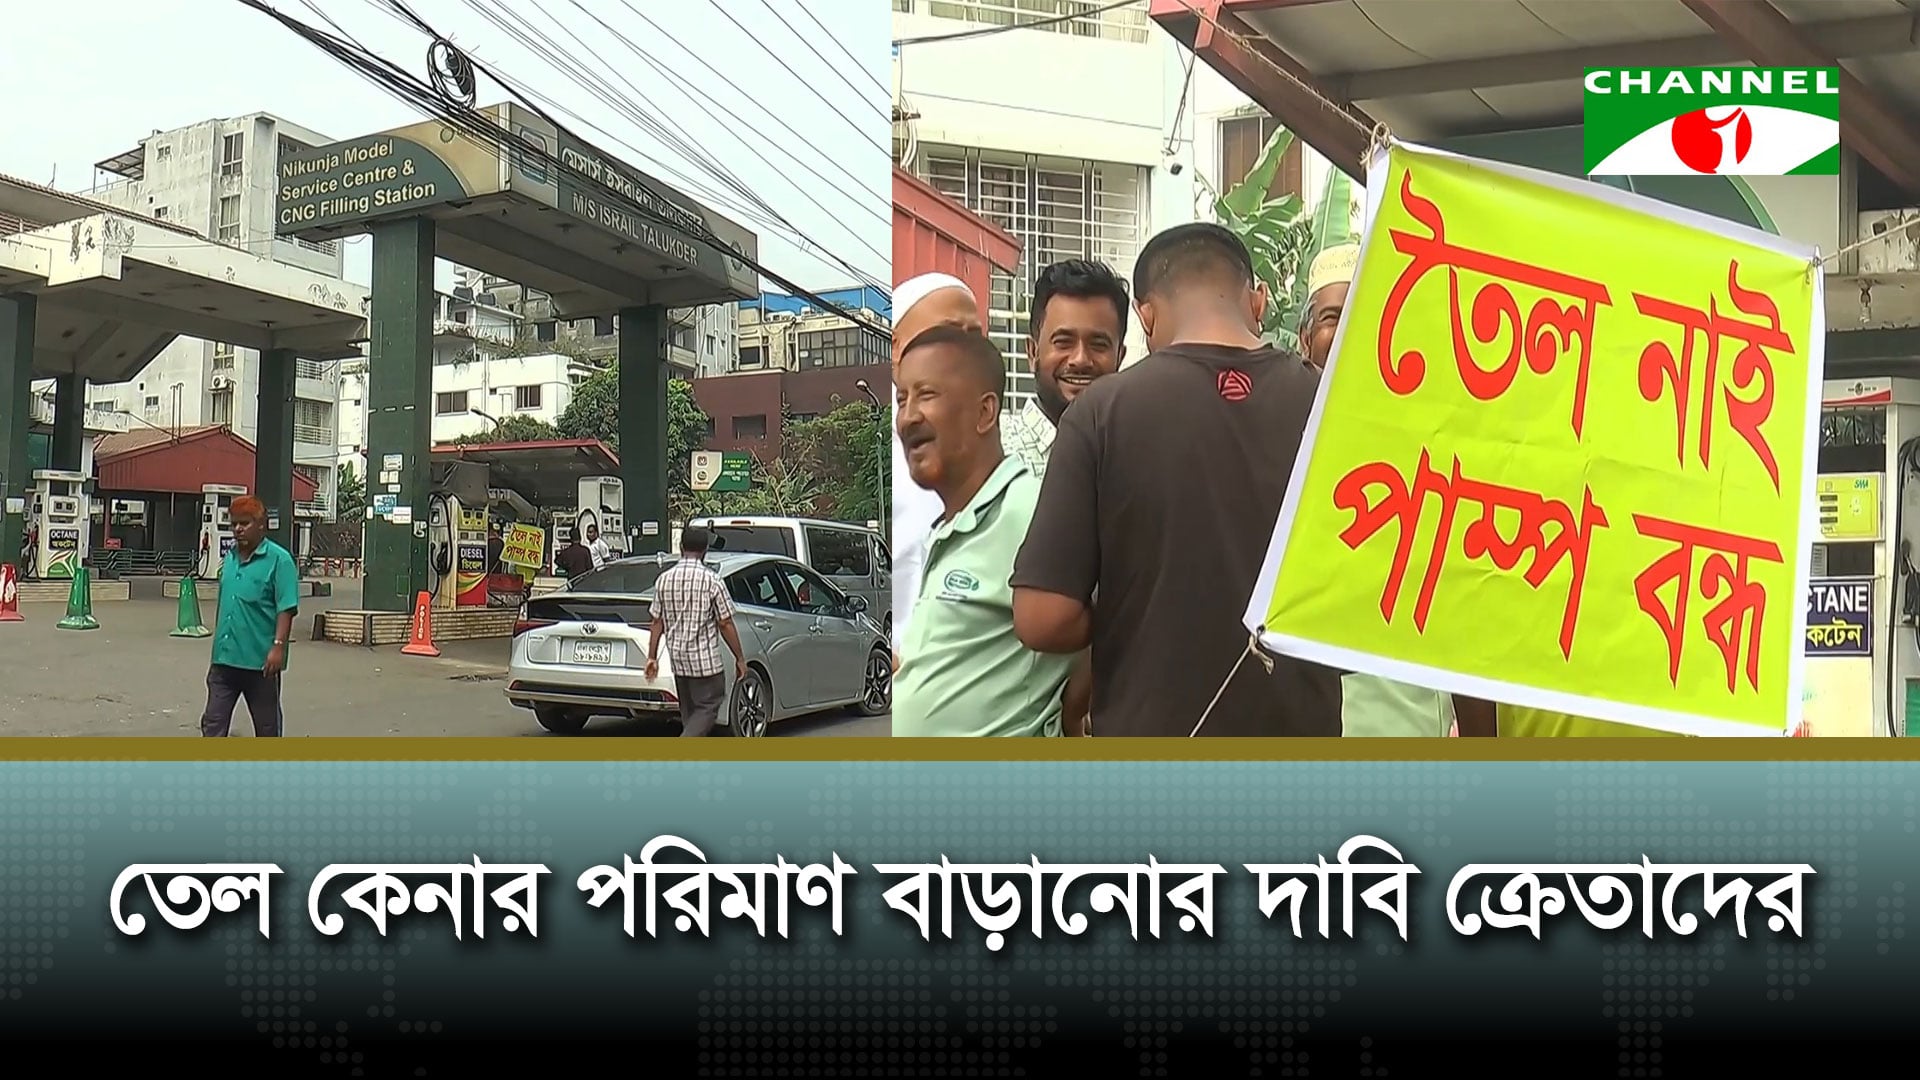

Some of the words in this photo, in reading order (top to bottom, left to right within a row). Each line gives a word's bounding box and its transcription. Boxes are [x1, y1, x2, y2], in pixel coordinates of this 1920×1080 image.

[282, 153, 340, 179] Nikunja
[344, 139, 394, 165] Model
[281, 179, 338, 201] Service
[342, 166, 397, 188] Centre
[402, 159, 415, 176] &
[280, 204, 316, 225] CNG
[320, 195, 369, 217] Filling
[374, 183, 435, 206] Station
[573, 193, 597, 220] M/S
[600, 204, 639, 239] ISRAIL
[641, 223, 698, 266] TALUKDER
[1377, 168, 1613, 443] তৈল
[1631, 258, 1796, 499] নাই
[50, 530, 78, 539] OCTANE
[460, 547, 484, 559] DIESEL
[1333, 445, 1611, 663] পাম্প
[1631, 512, 1784, 696] বন্ধ
[1807, 586, 1868, 613] TANE
[1807, 616, 1864, 649] কটেন
